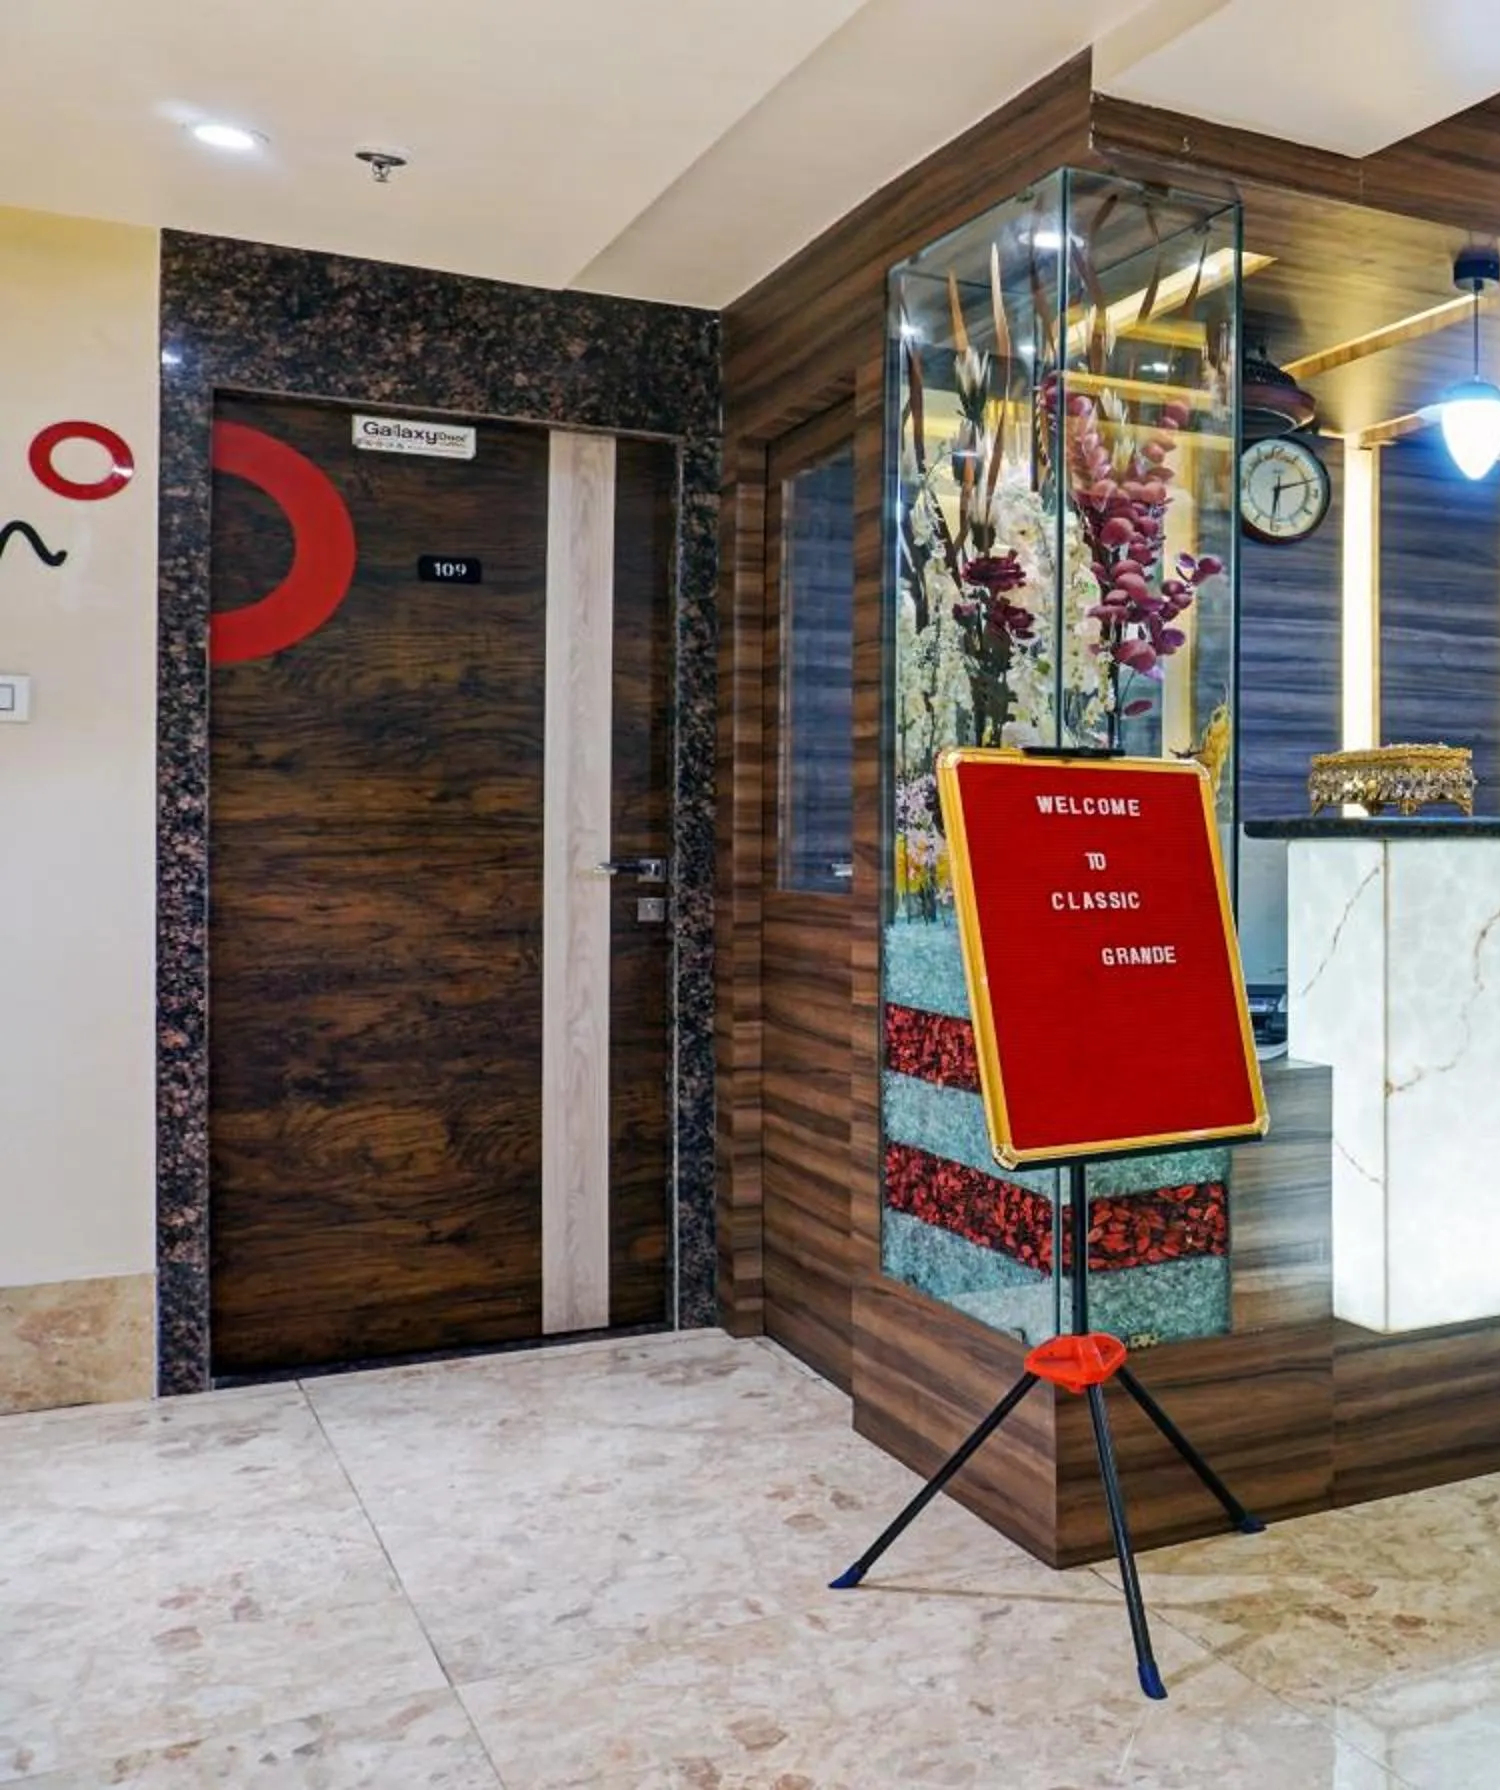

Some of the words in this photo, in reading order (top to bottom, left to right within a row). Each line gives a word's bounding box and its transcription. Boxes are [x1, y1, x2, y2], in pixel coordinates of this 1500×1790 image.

[362, 421, 438, 445] Galaxy
[433, 562, 467, 577] 109
[1036, 795, 1141, 817] WELCOME
[1084, 852, 1107, 871] TO
[1051, 891, 1141, 911] CLASSIC
[1101, 945, 1177, 966] GRANDE
